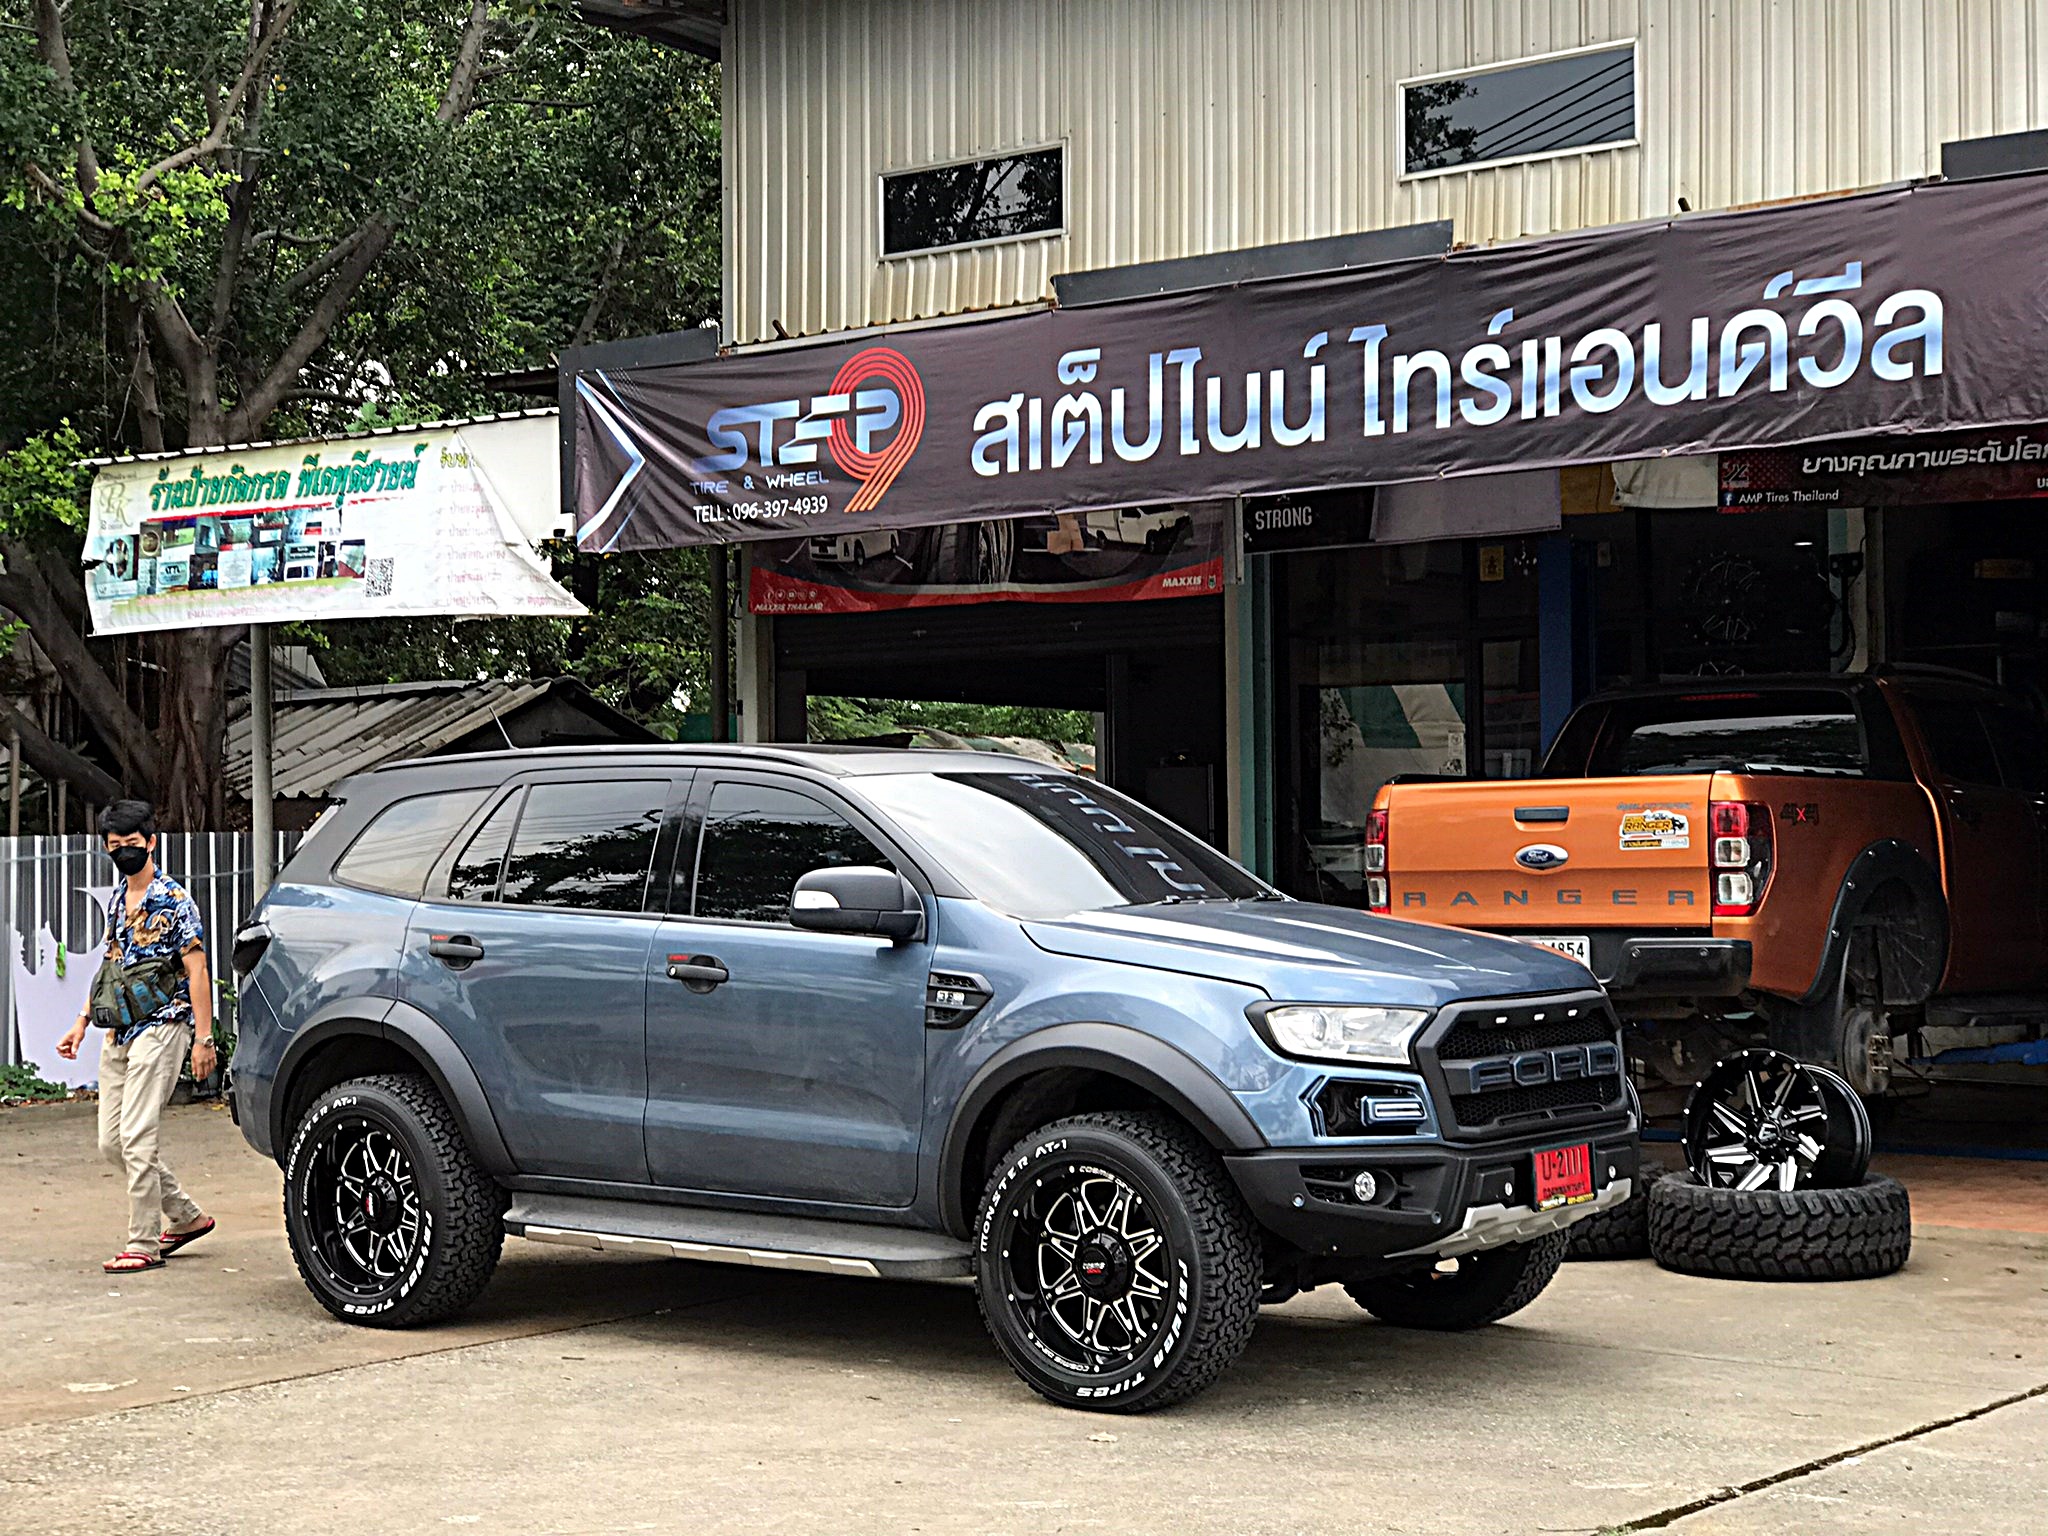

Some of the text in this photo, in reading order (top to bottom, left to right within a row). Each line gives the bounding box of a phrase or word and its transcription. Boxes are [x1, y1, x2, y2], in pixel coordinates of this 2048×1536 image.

[970, 260, 1945, 477] สเต็ปไนน์ ไทร์แอนด์วีล
[690, 388, 900, 474] STEP
[690, 470, 830, 494] TIRE & WHEEL
[732, 495, 829, 520] 096-397-4939
[1738, 489, 1839, 504] AMP Tires Thailand
[1254, 506, 1313, 530] STRONG
[1162, 575, 1202, 588] MAXXIS
[1402, 888, 1695, 907] RANGER
[1469, 1045, 1619, 1093] FORD
[287, 1106, 328, 1180] MONSTER
[980, 1139, 1068, 1252] MONSTER AT-1
